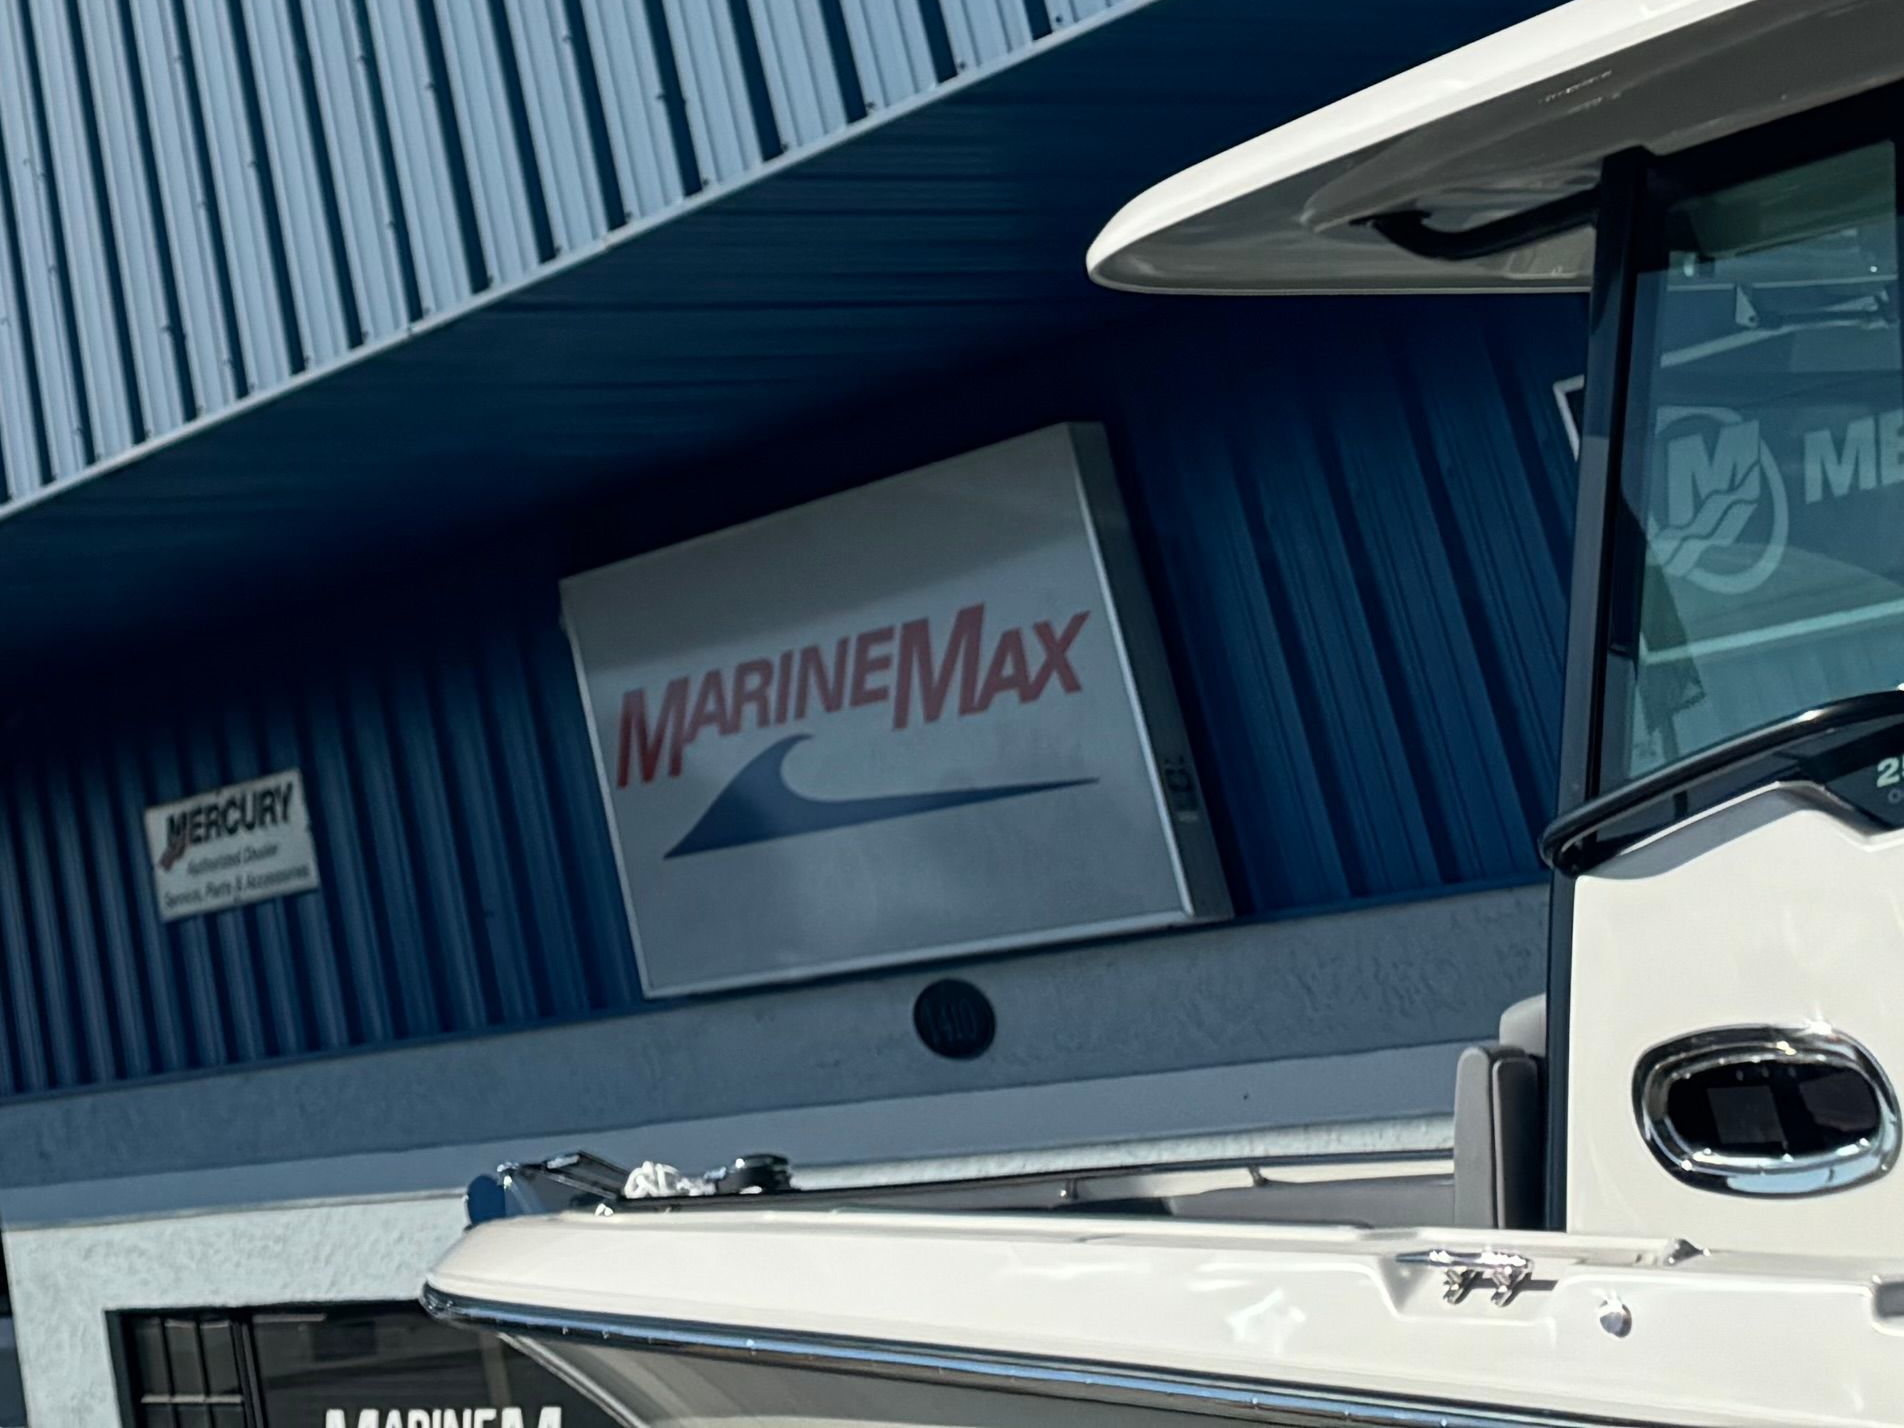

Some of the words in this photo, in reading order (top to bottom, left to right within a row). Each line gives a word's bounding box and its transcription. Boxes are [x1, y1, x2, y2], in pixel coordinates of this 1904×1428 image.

[617, 602, 1091, 788] MARINEMAX
[1876, 753, 1904, 788] 2
[165, 782, 293, 846] MERCURY
